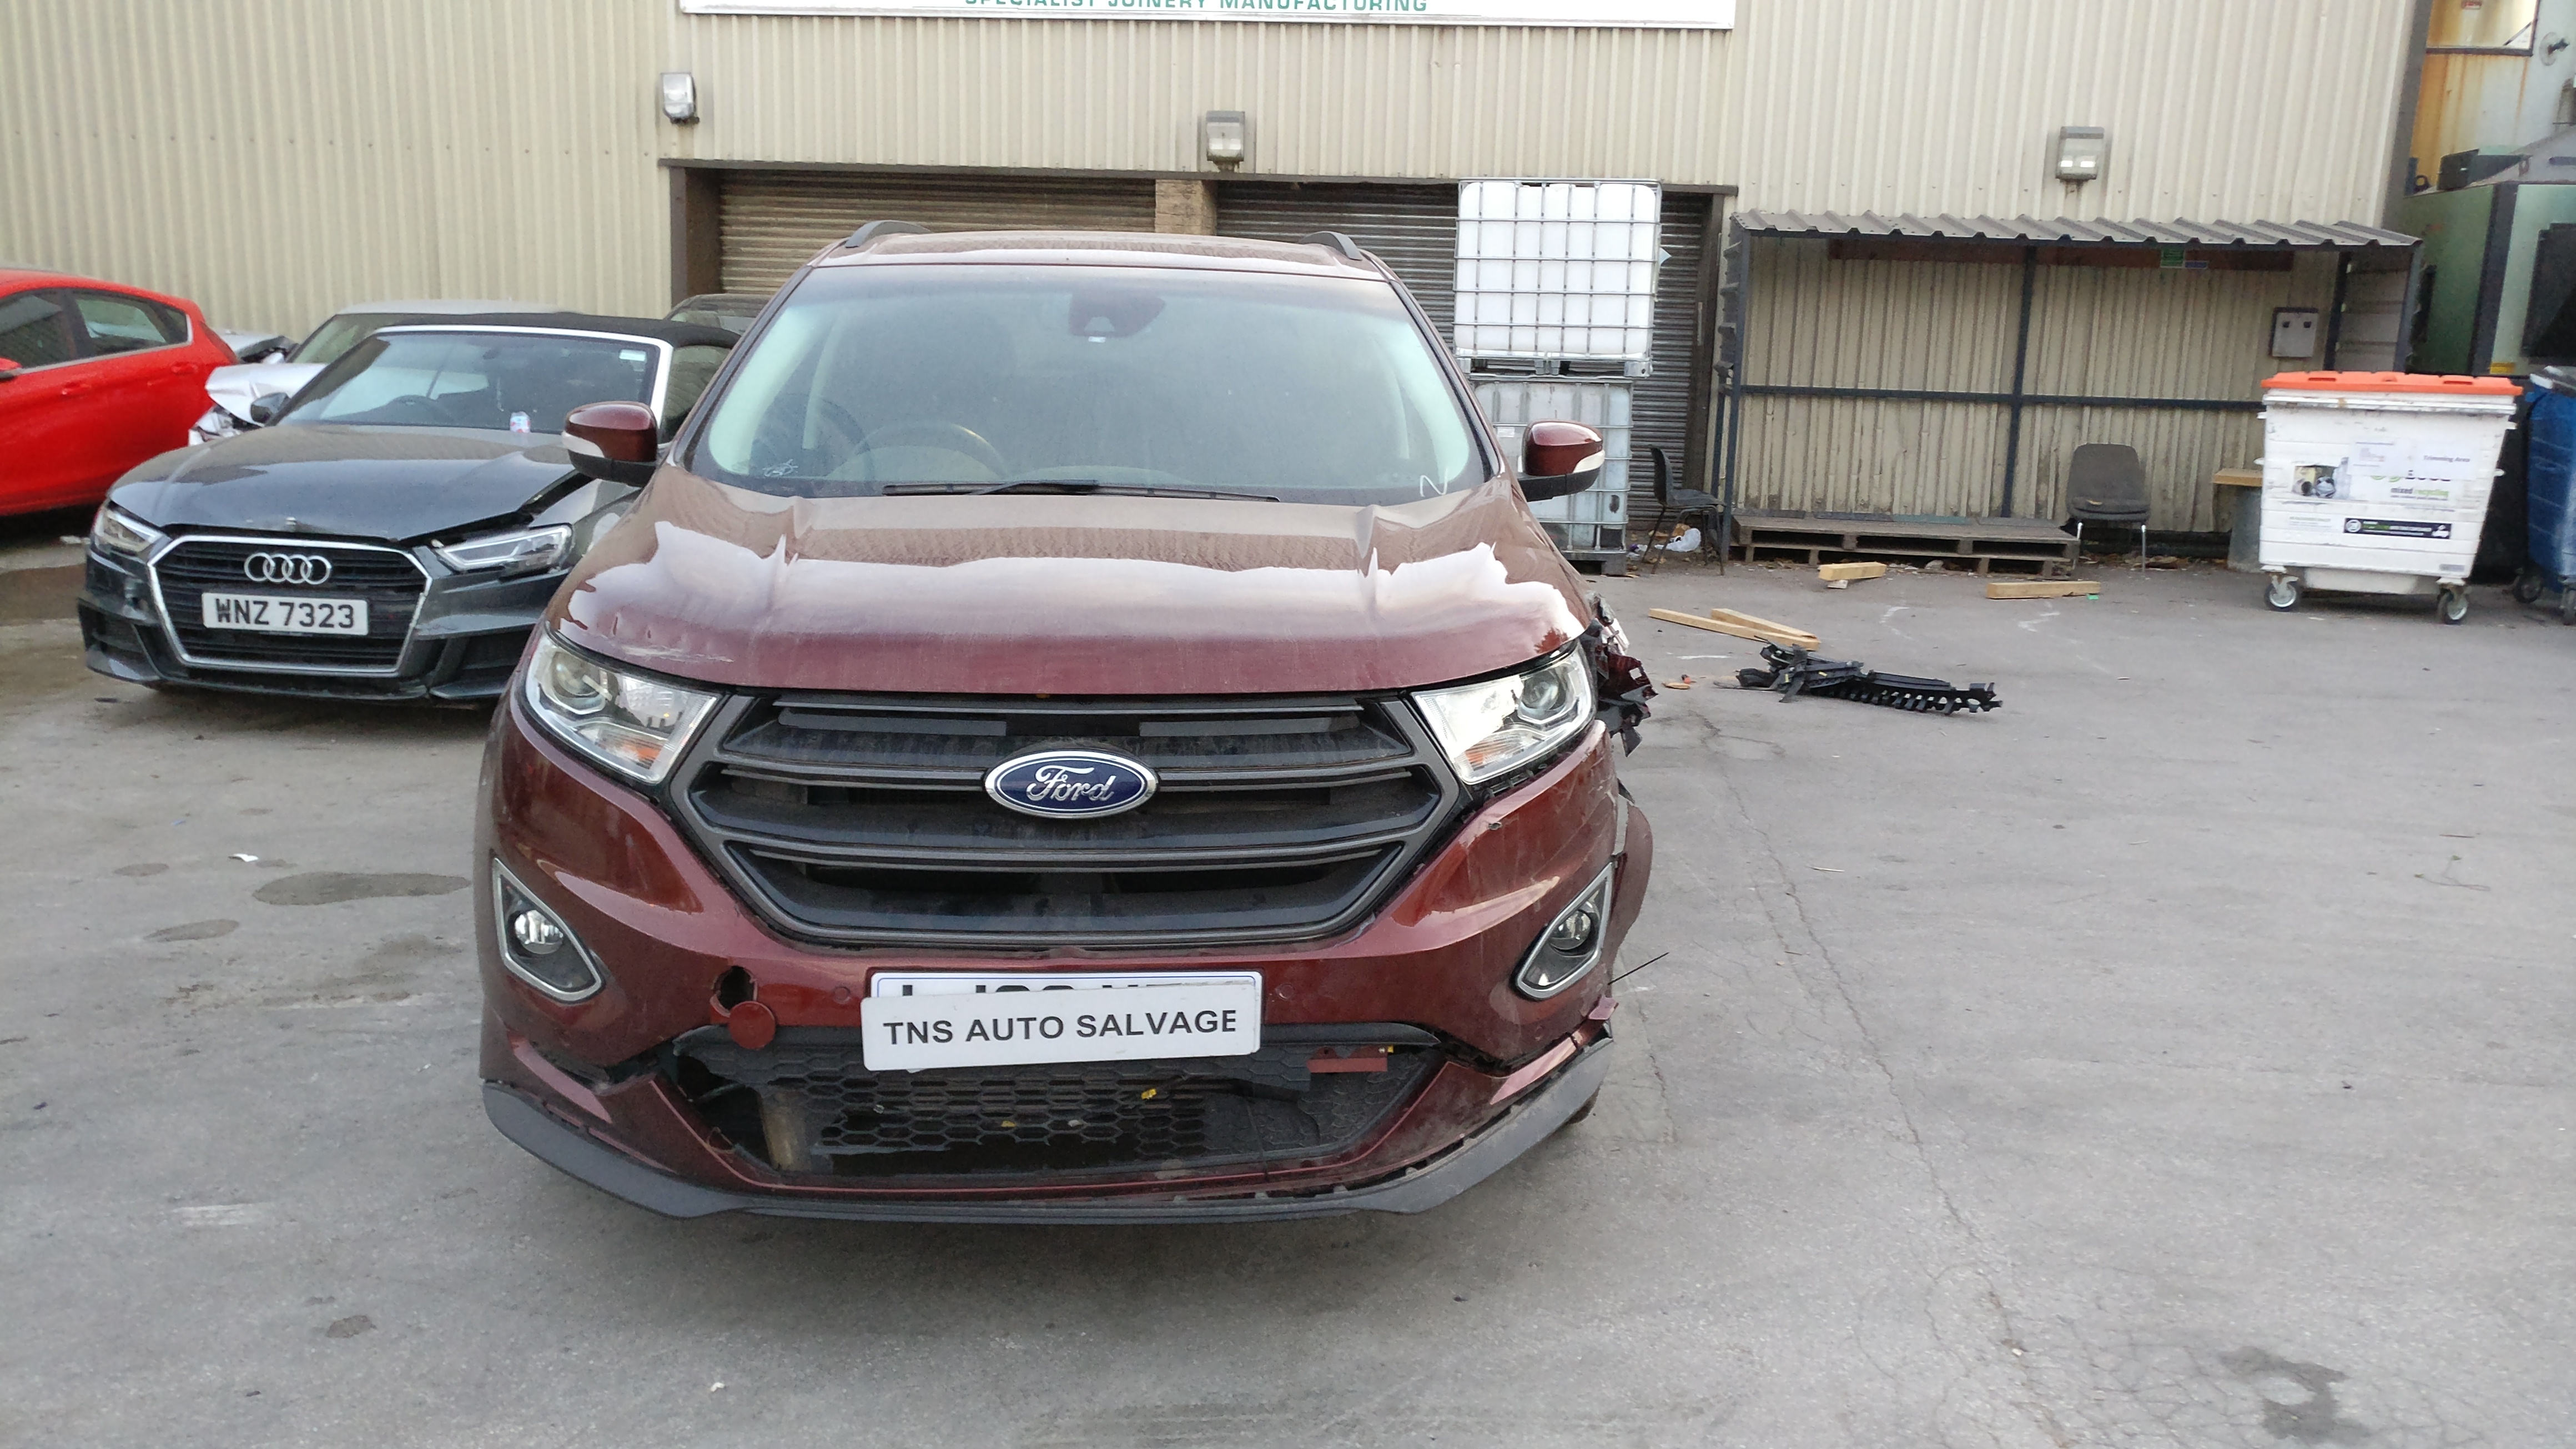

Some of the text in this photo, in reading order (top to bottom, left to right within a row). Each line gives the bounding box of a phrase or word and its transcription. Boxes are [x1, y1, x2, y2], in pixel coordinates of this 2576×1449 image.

[1220, 0, 1427, 11] MANUFACTURING
[216, 598, 353, 628] WNZ 7323
[1026, 764, 1117, 802] Ford
[883, 1010, 1235, 1044] TNS AUTO SALVAGE
